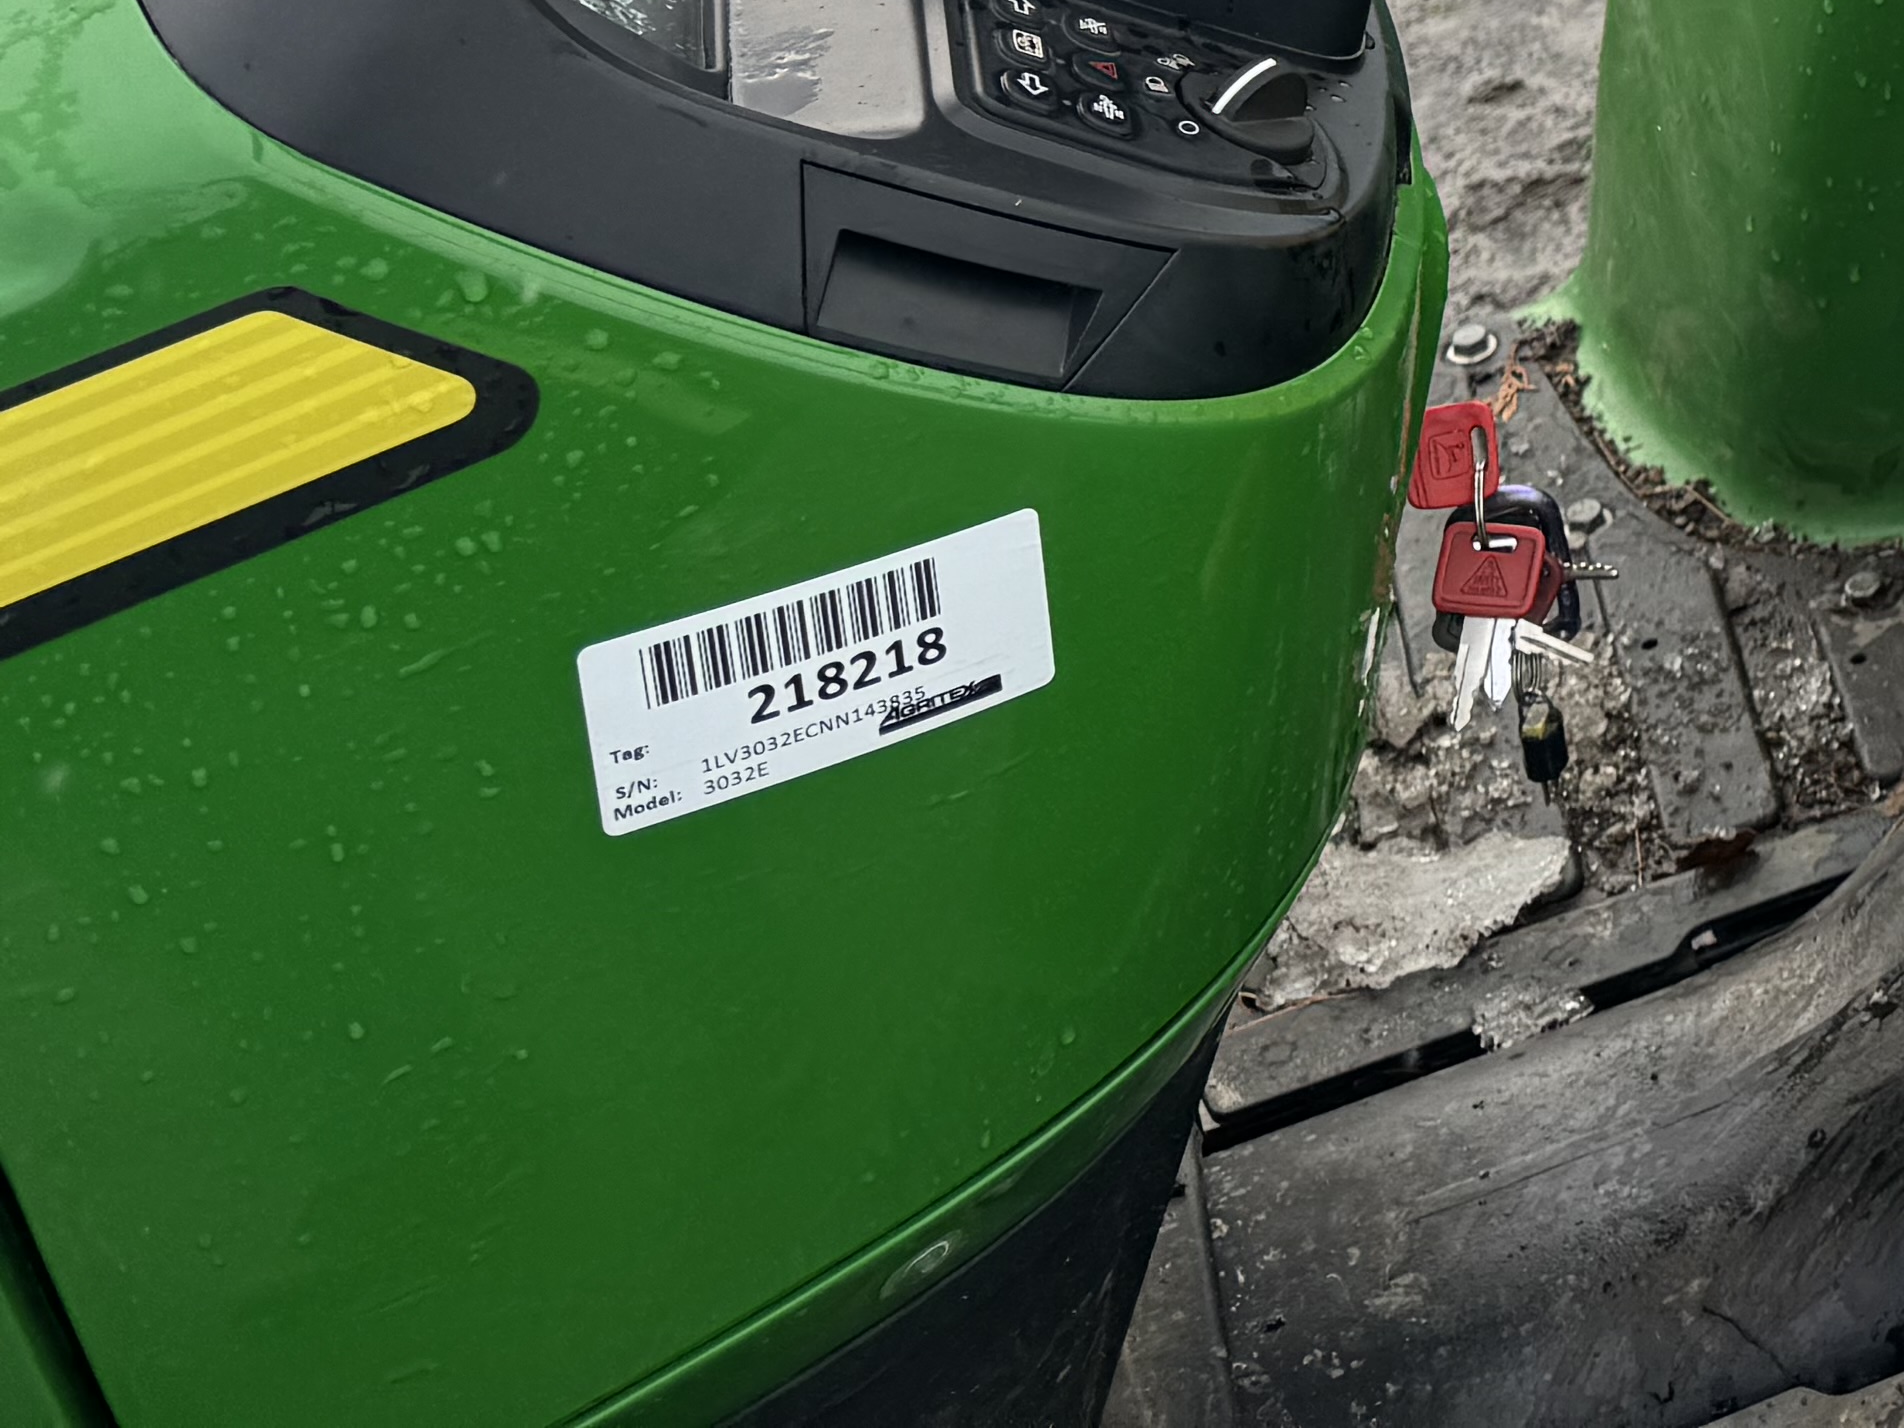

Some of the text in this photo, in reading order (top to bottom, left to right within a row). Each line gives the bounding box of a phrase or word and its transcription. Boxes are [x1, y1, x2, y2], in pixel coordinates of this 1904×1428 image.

[748, 626, 947, 724] 218218
[609, 744, 650, 764] Tag:
[614, 761, 770, 822] Model: 3032E
[615, 777, 658, 800] S/N:
